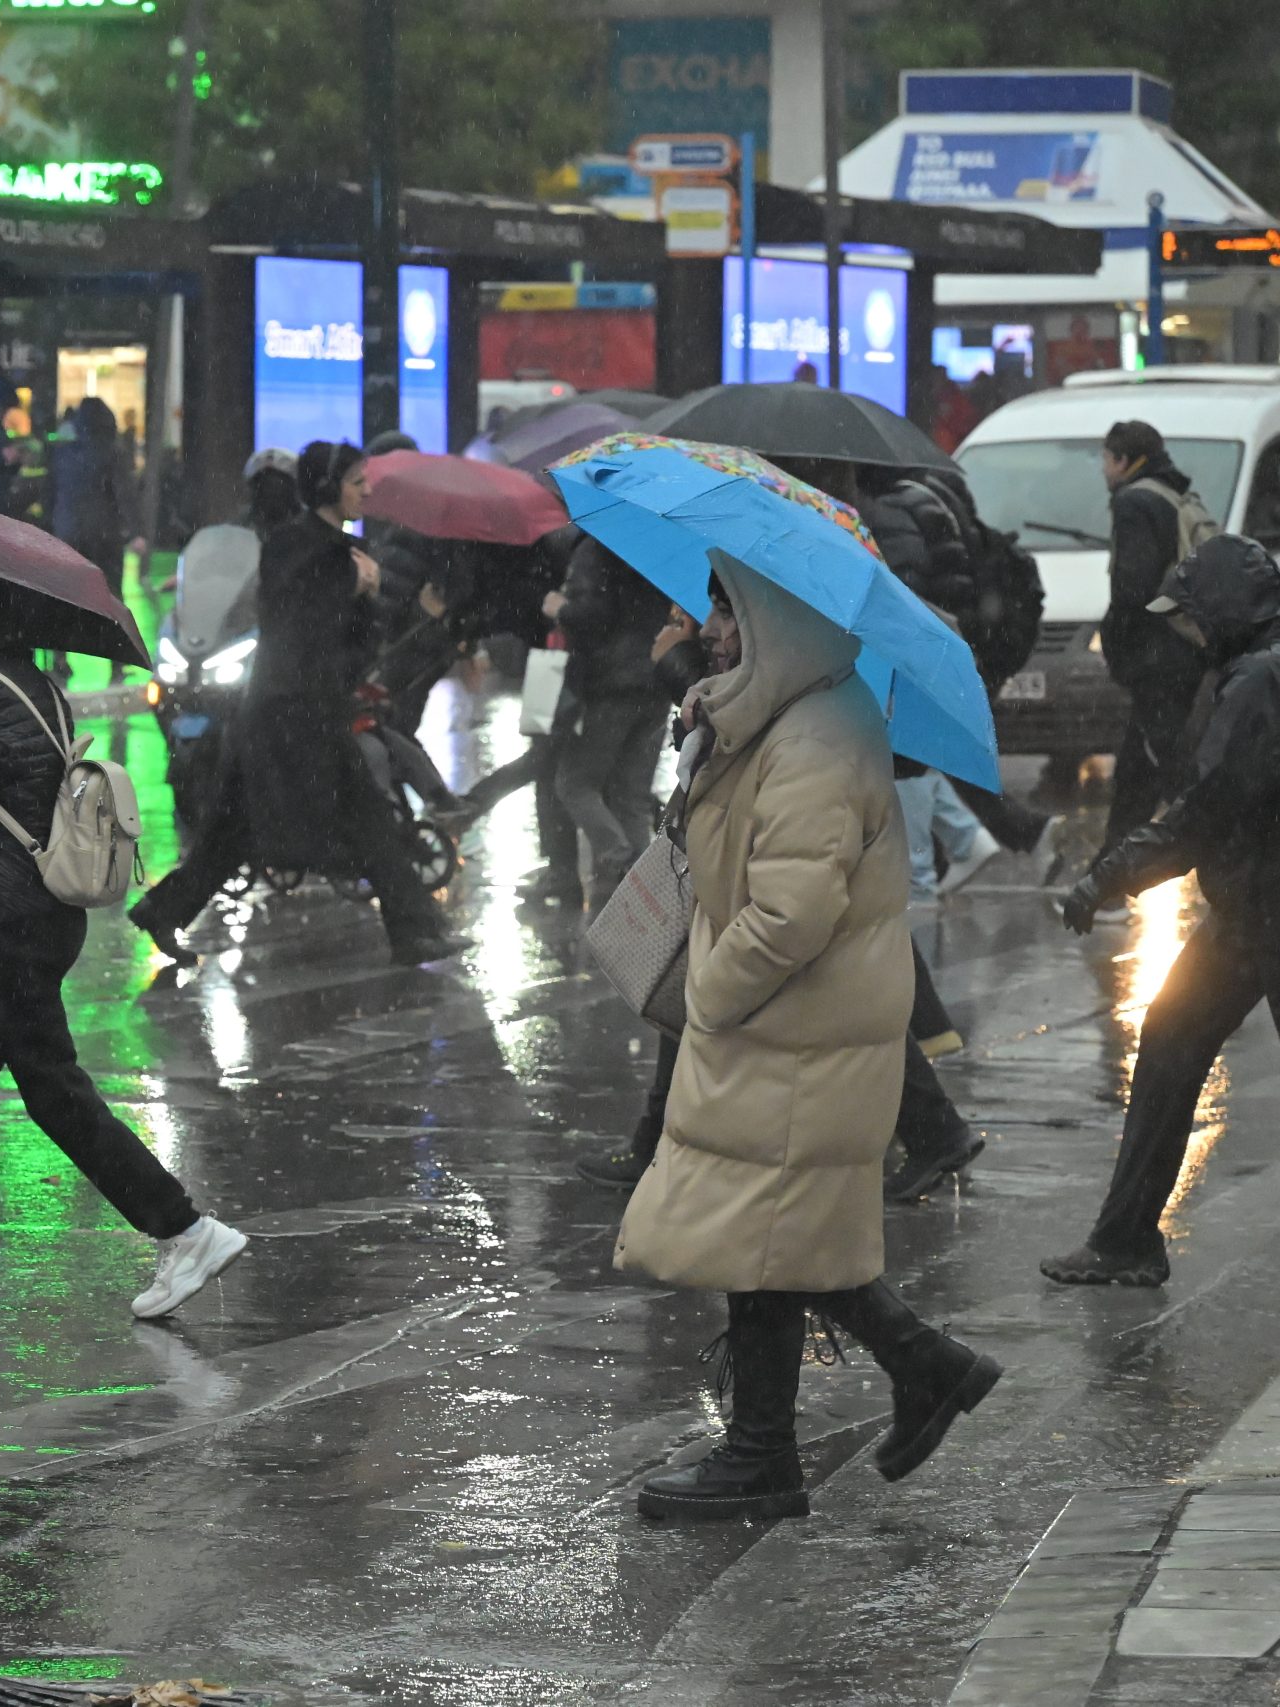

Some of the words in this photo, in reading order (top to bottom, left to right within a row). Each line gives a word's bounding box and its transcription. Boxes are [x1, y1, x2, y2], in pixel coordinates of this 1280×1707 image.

[621, 53, 770, 91] EXCHA
[265, 320, 324, 359] Smart
[791, 317, 850, 355] Athes
